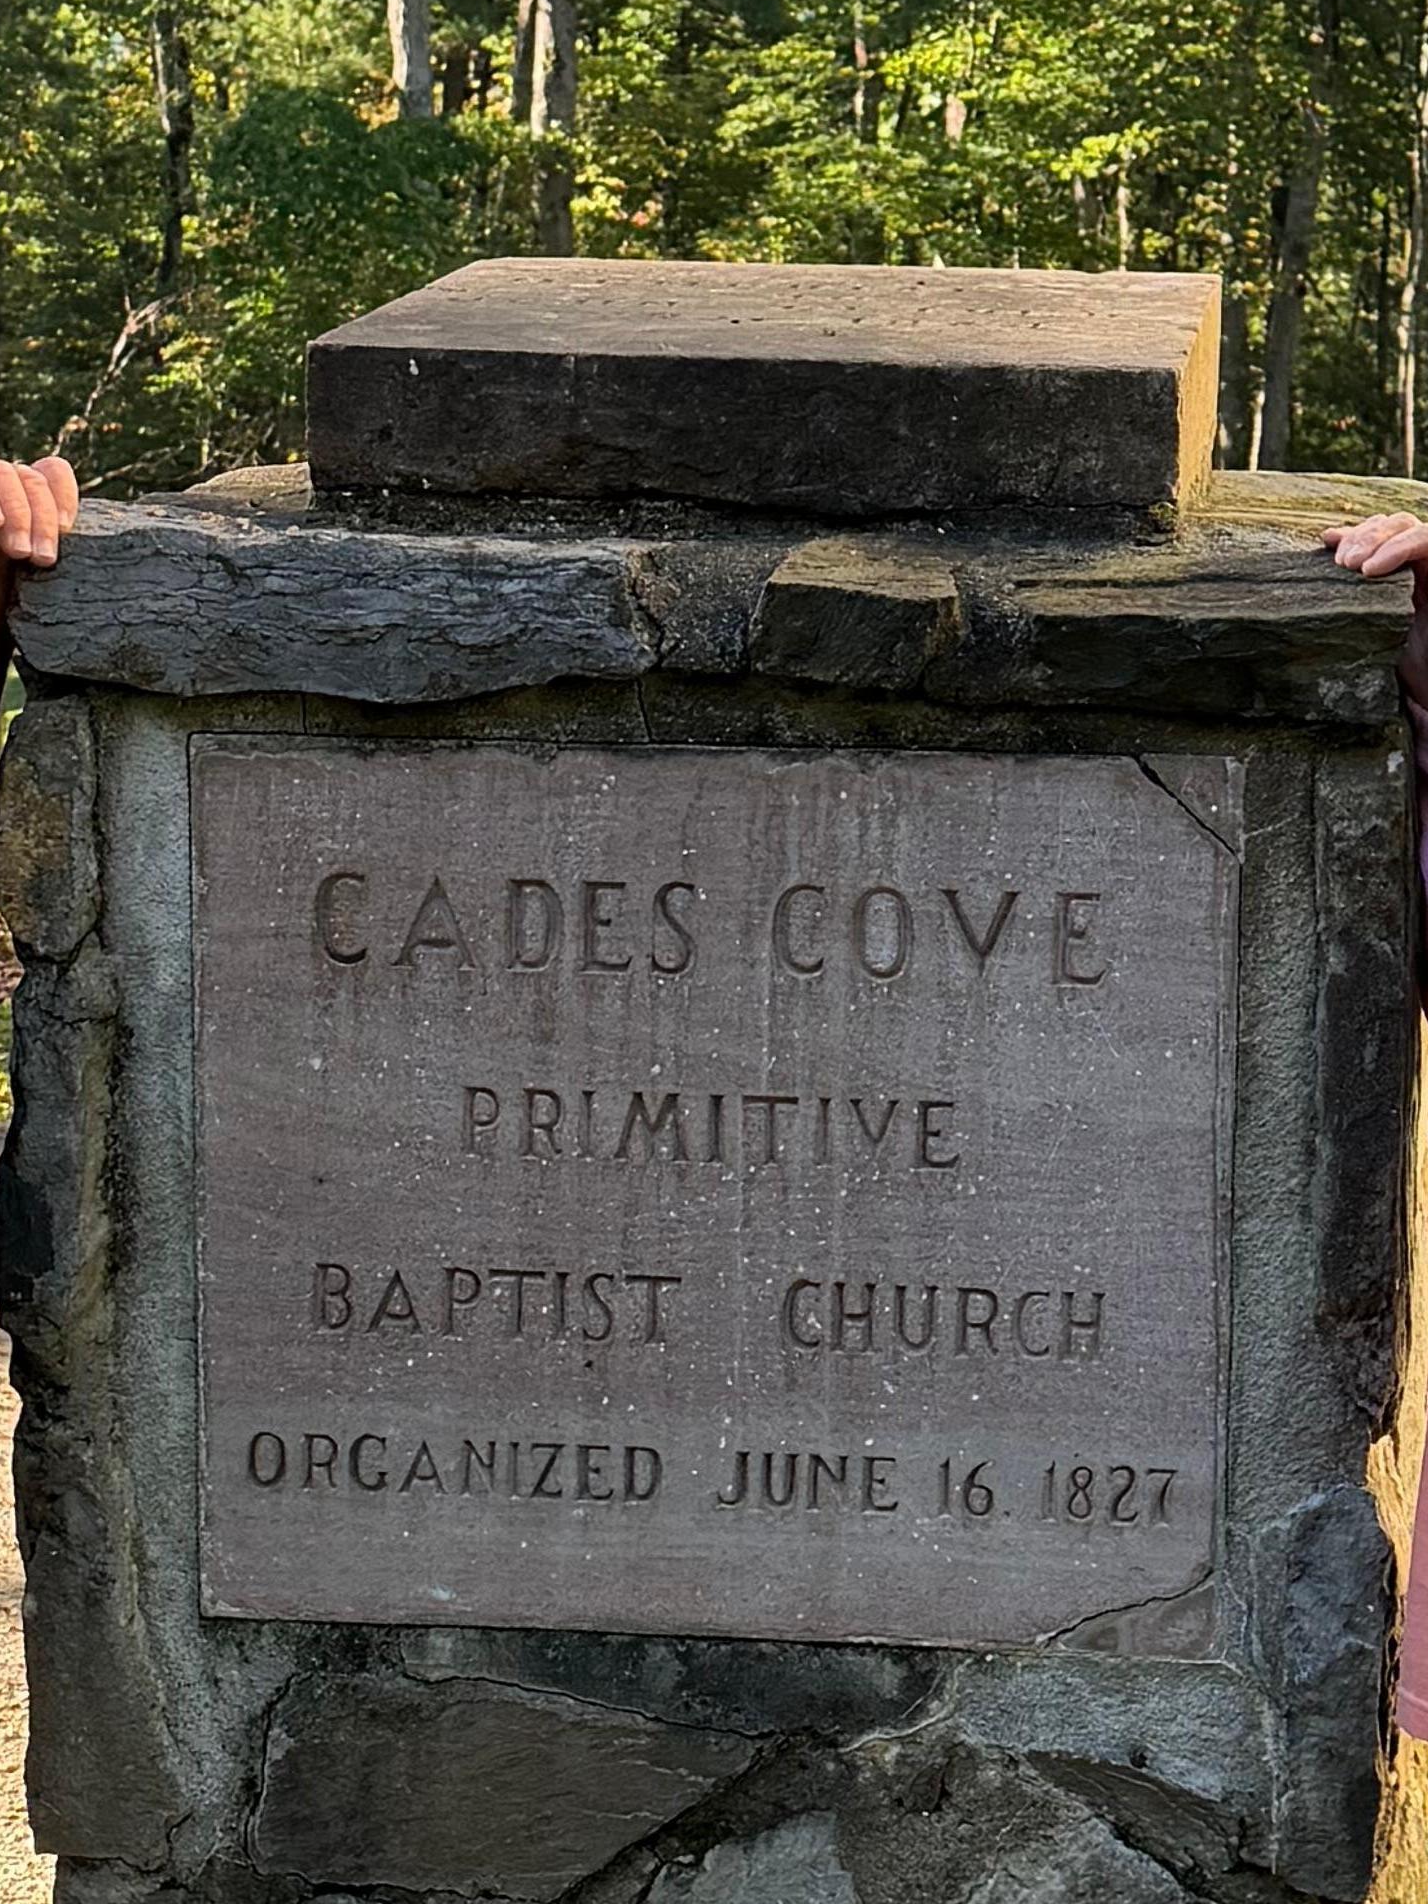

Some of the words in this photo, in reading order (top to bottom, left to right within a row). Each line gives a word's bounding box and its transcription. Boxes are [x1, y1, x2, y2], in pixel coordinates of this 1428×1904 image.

[314, 870, 697, 975] CADES
[772, 883, 1111, 986] COVE
[461, 1085, 961, 1171] PRIMITIVE
[312, 1262, 682, 1345] BAPTIST
[782, 1278, 1106, 1362] CHURCH
[247, 1430, 664, 1504] ORGANIZED
[716, 1450, 899, 1514] JUNE
[1040, 1459, 1179, 1528] 1827
